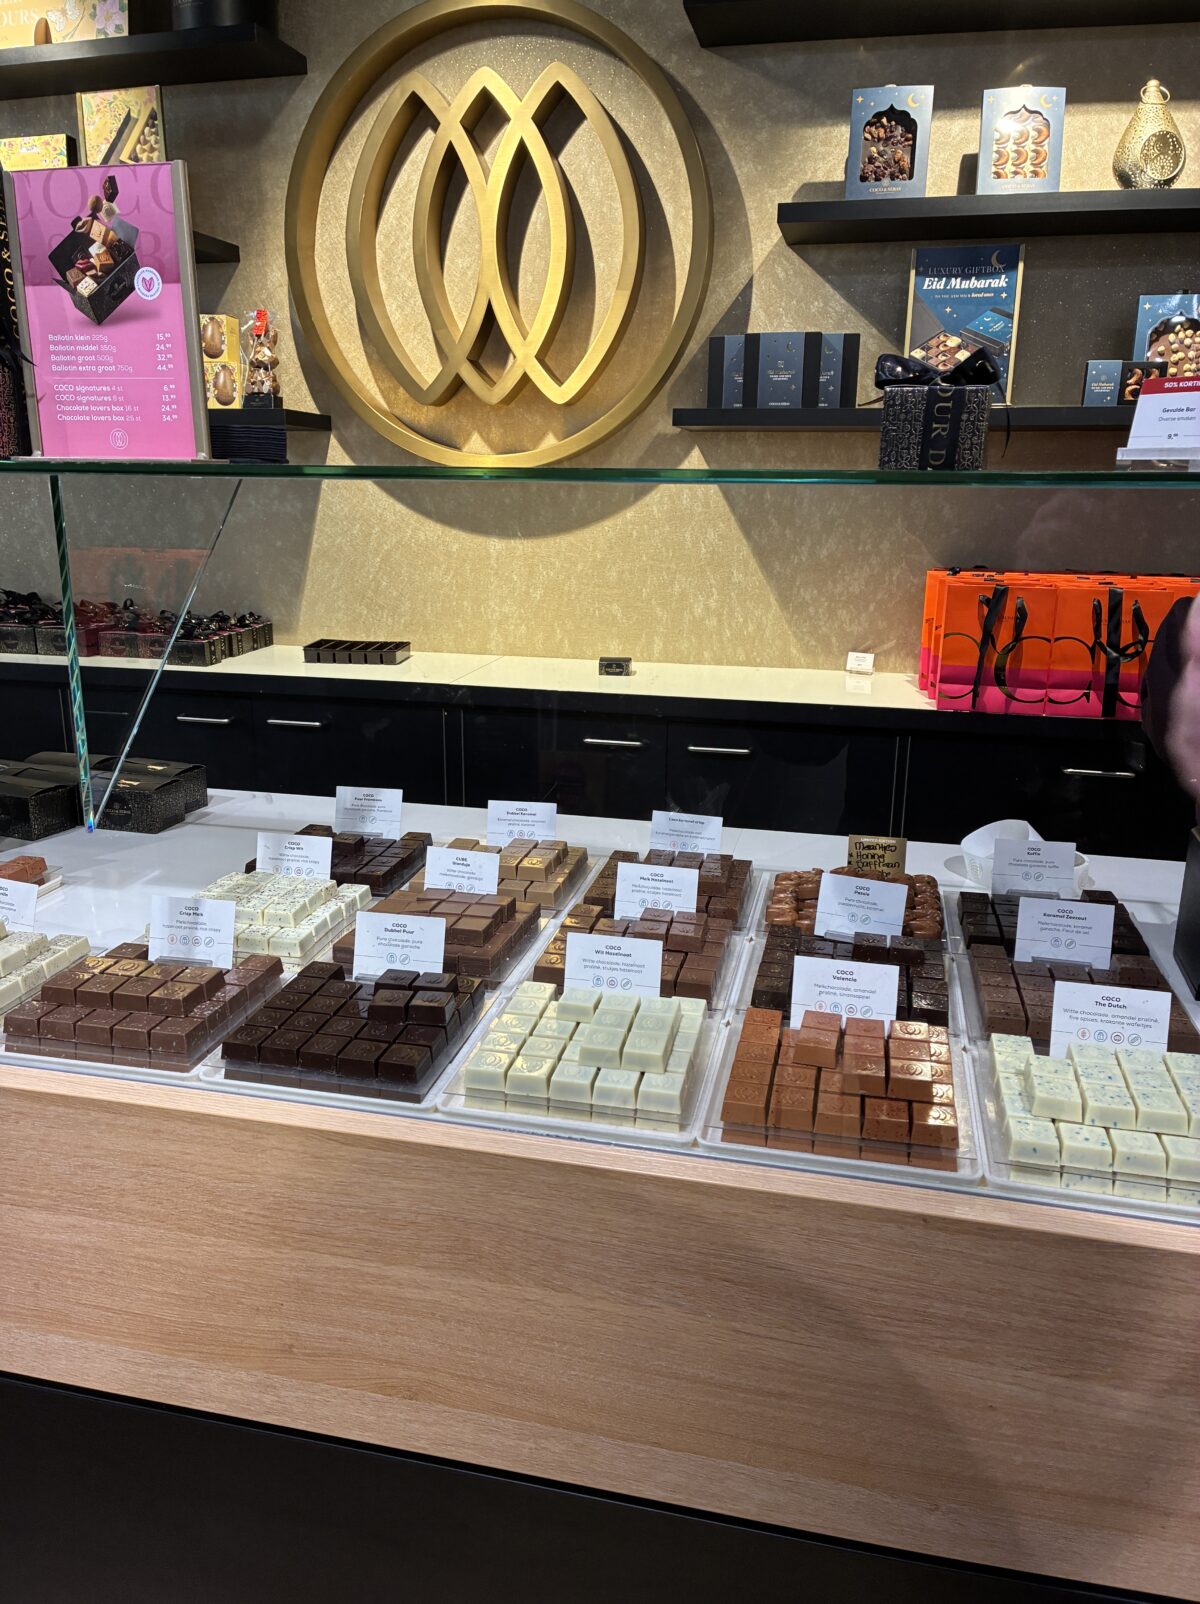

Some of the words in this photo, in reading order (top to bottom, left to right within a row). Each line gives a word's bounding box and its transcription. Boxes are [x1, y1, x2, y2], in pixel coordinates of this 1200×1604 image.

[928, 267, 962, 275] LUXURY
[965, 265, 1005, 274] GIFTBOX
[922, 277, 946, 290] Eid
[947, 275, 1008, 289] Mubarak
[98, 365, 115, 373] groot
[76, 384, 110, 393] signatures
[76, 394, 112, 403] signatures
